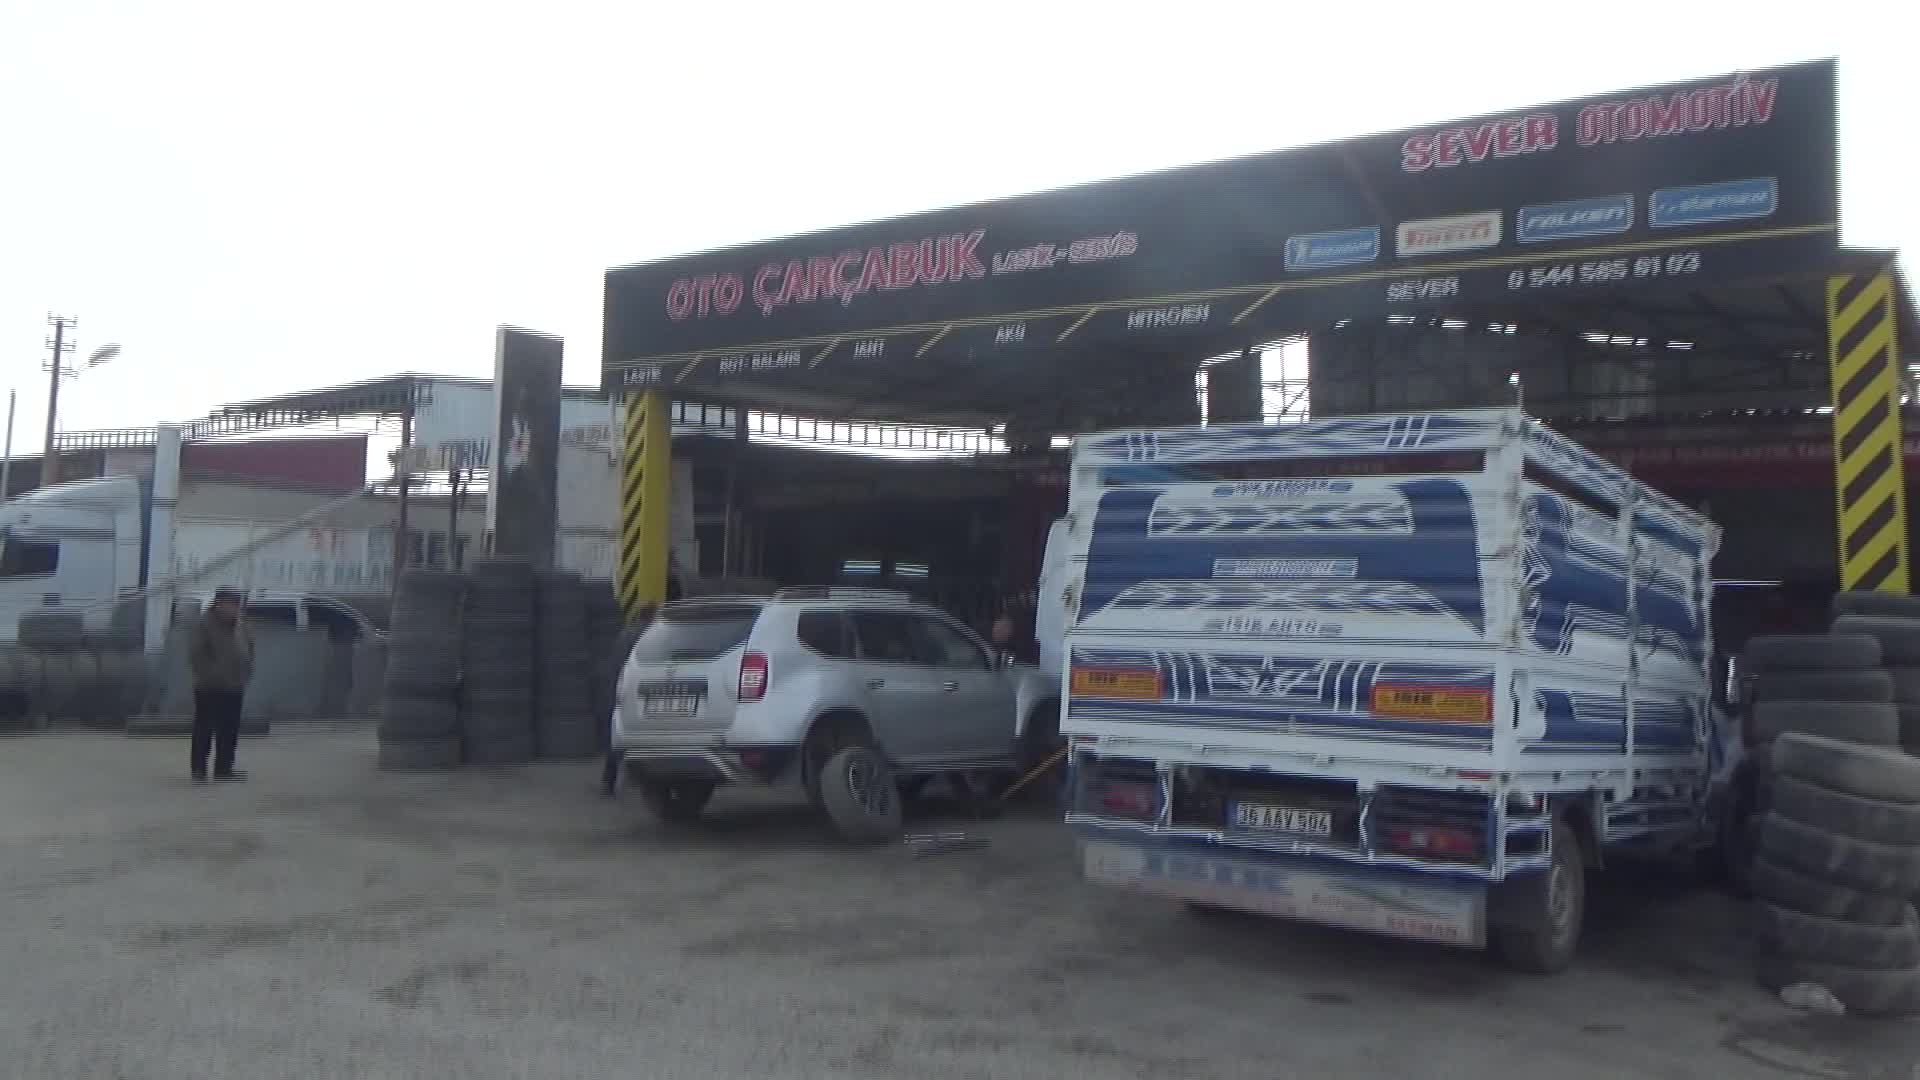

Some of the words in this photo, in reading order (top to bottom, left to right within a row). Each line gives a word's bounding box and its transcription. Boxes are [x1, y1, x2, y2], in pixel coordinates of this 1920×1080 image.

[1402, 115, 1558, 171] SEVER
[1577, 73, 1778, 145] OTOMOTİV
[666, 273, 744, 320] OTO
[753, 230, 986, 316] ÇARÇABUK
[1507, 269, 1525, 290] 0
[1529, 264, 1575, 288] 544
[1579, 258, 1628, 283] 585
[1666, 251, 1702, 275] 03
[1386, 276, 1460, 302] SEVER
[853, 338, 887, 360] JANT
[1238, 803, 1258, 826] 36
[1263, 807, 1293, 830] AAV
[1297, 811, 1328, 833] 504
